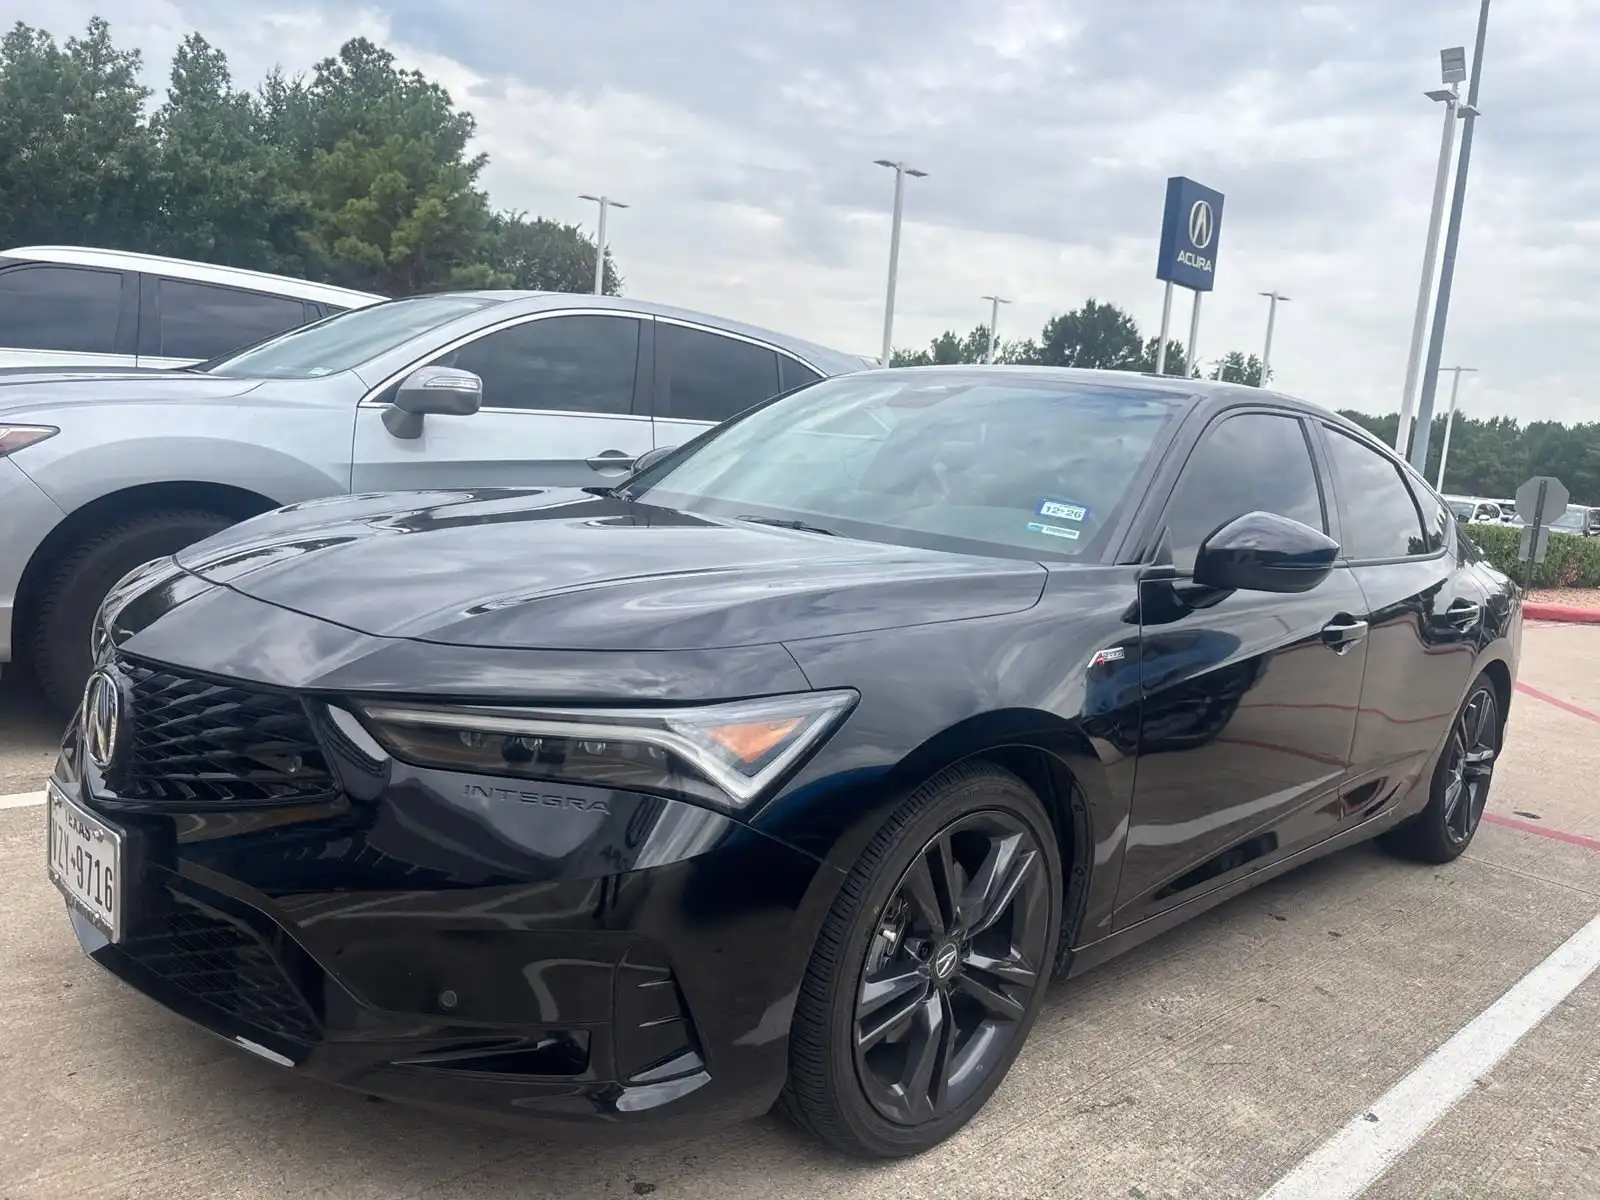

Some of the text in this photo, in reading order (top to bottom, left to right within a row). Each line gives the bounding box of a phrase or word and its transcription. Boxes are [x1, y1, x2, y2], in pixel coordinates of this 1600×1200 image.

[1177, 250, 1212, 272] ACURA
[1046, 505, 1082, 519] 12-26
[463, 784, 612, 815] INTEGRA
[65, 810, 91, 842] TEXAS
